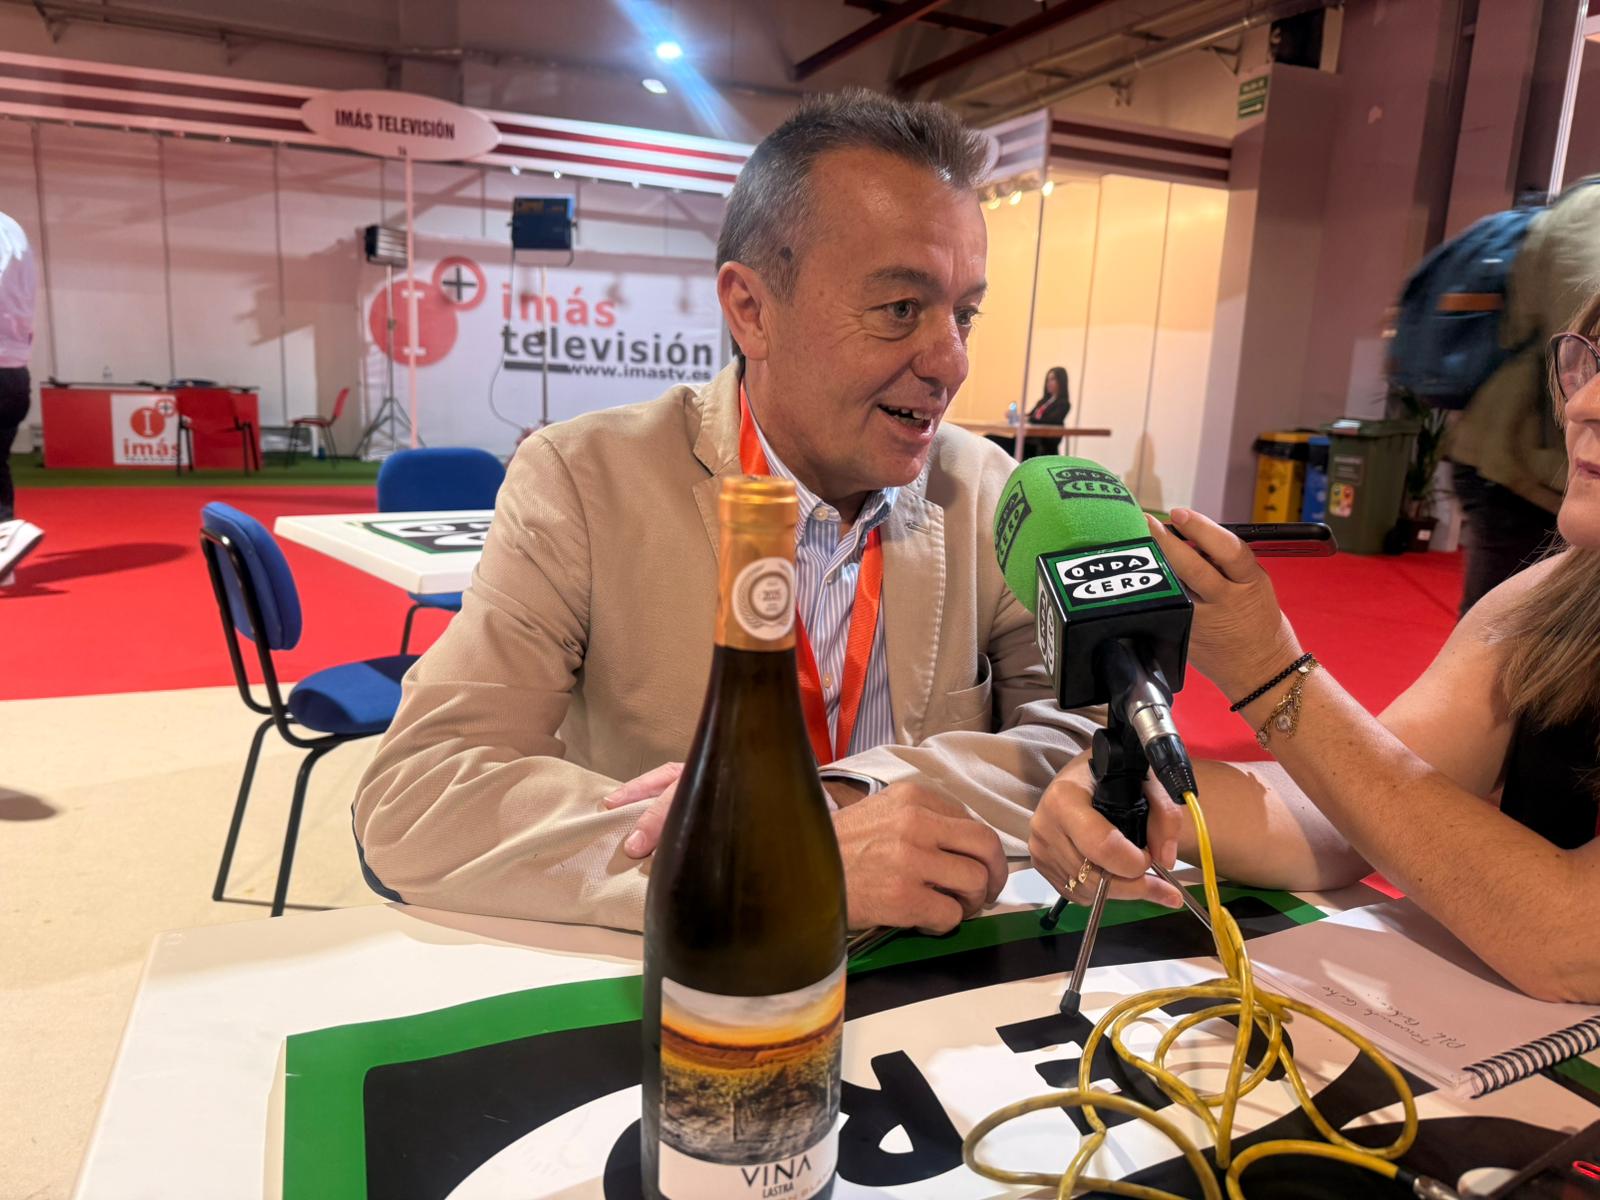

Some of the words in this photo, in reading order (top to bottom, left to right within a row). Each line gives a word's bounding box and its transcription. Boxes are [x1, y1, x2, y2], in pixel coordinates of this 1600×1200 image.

[335, 108, 373, 130] IMÁS
[377, 115, 455, 140] TELEVISIÓN
[502, 283, 617, 328] imás
[501, 324, 713, 367] televisión
[568, 364, 712, 382] www.imastv.es
[1072, 482, 1122, 494] CERO
[1071, 558, 1143, 577] ONDA
[1084, 575, 1151, 595] CERO
[763, 1183, 794, 1198] LASTRA
